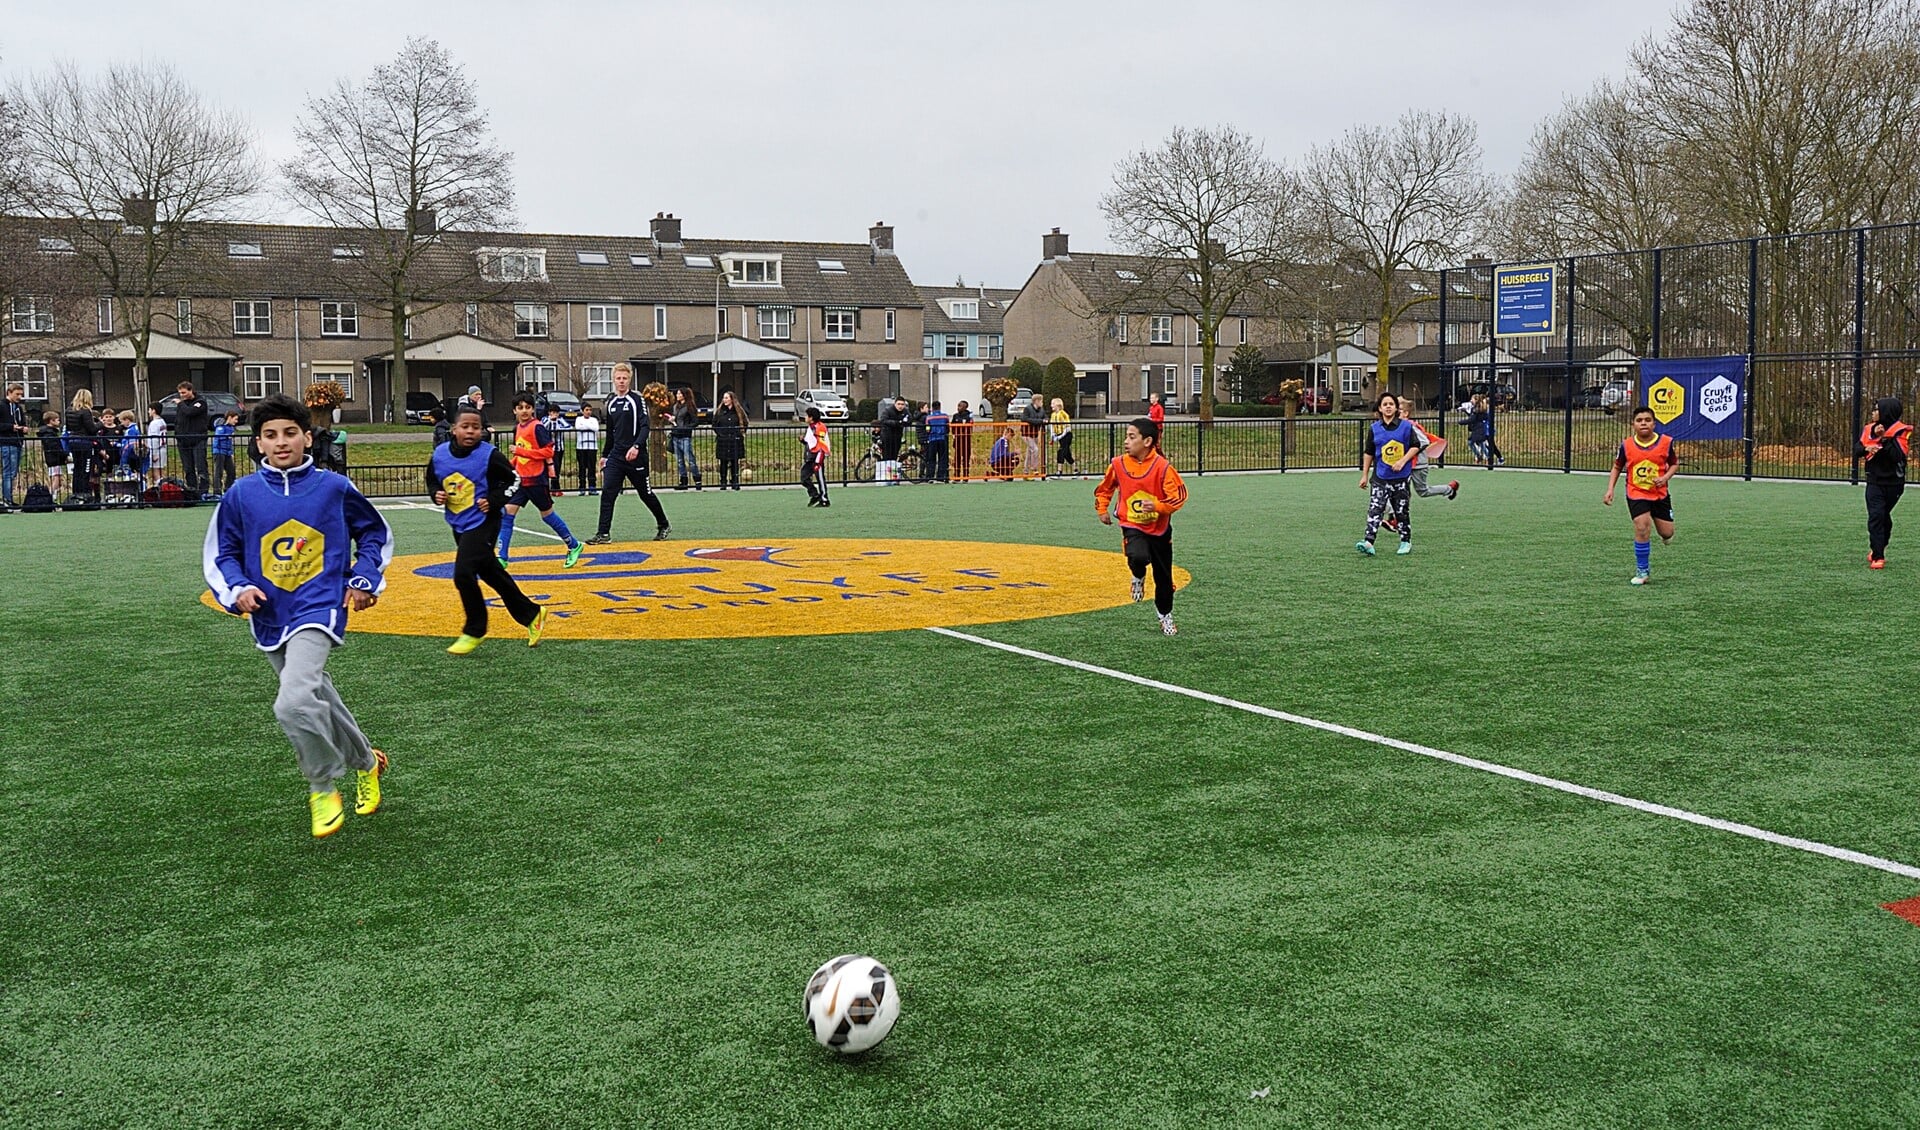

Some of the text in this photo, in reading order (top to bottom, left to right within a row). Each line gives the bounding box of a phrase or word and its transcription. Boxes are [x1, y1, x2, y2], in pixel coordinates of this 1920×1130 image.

[1501, 272, 1549, 284] HUISREGELS
[1704, 384, 1731, 397] Cruyff
[1704, 396, 1732, 405] Courts
[1708, 405, 1713, 413] 6
[1722, 403, 1728, 411] 6
[271, 561, 312, 572] CRUYFF
[550, 581, 1050, 618] FOUNDATION
